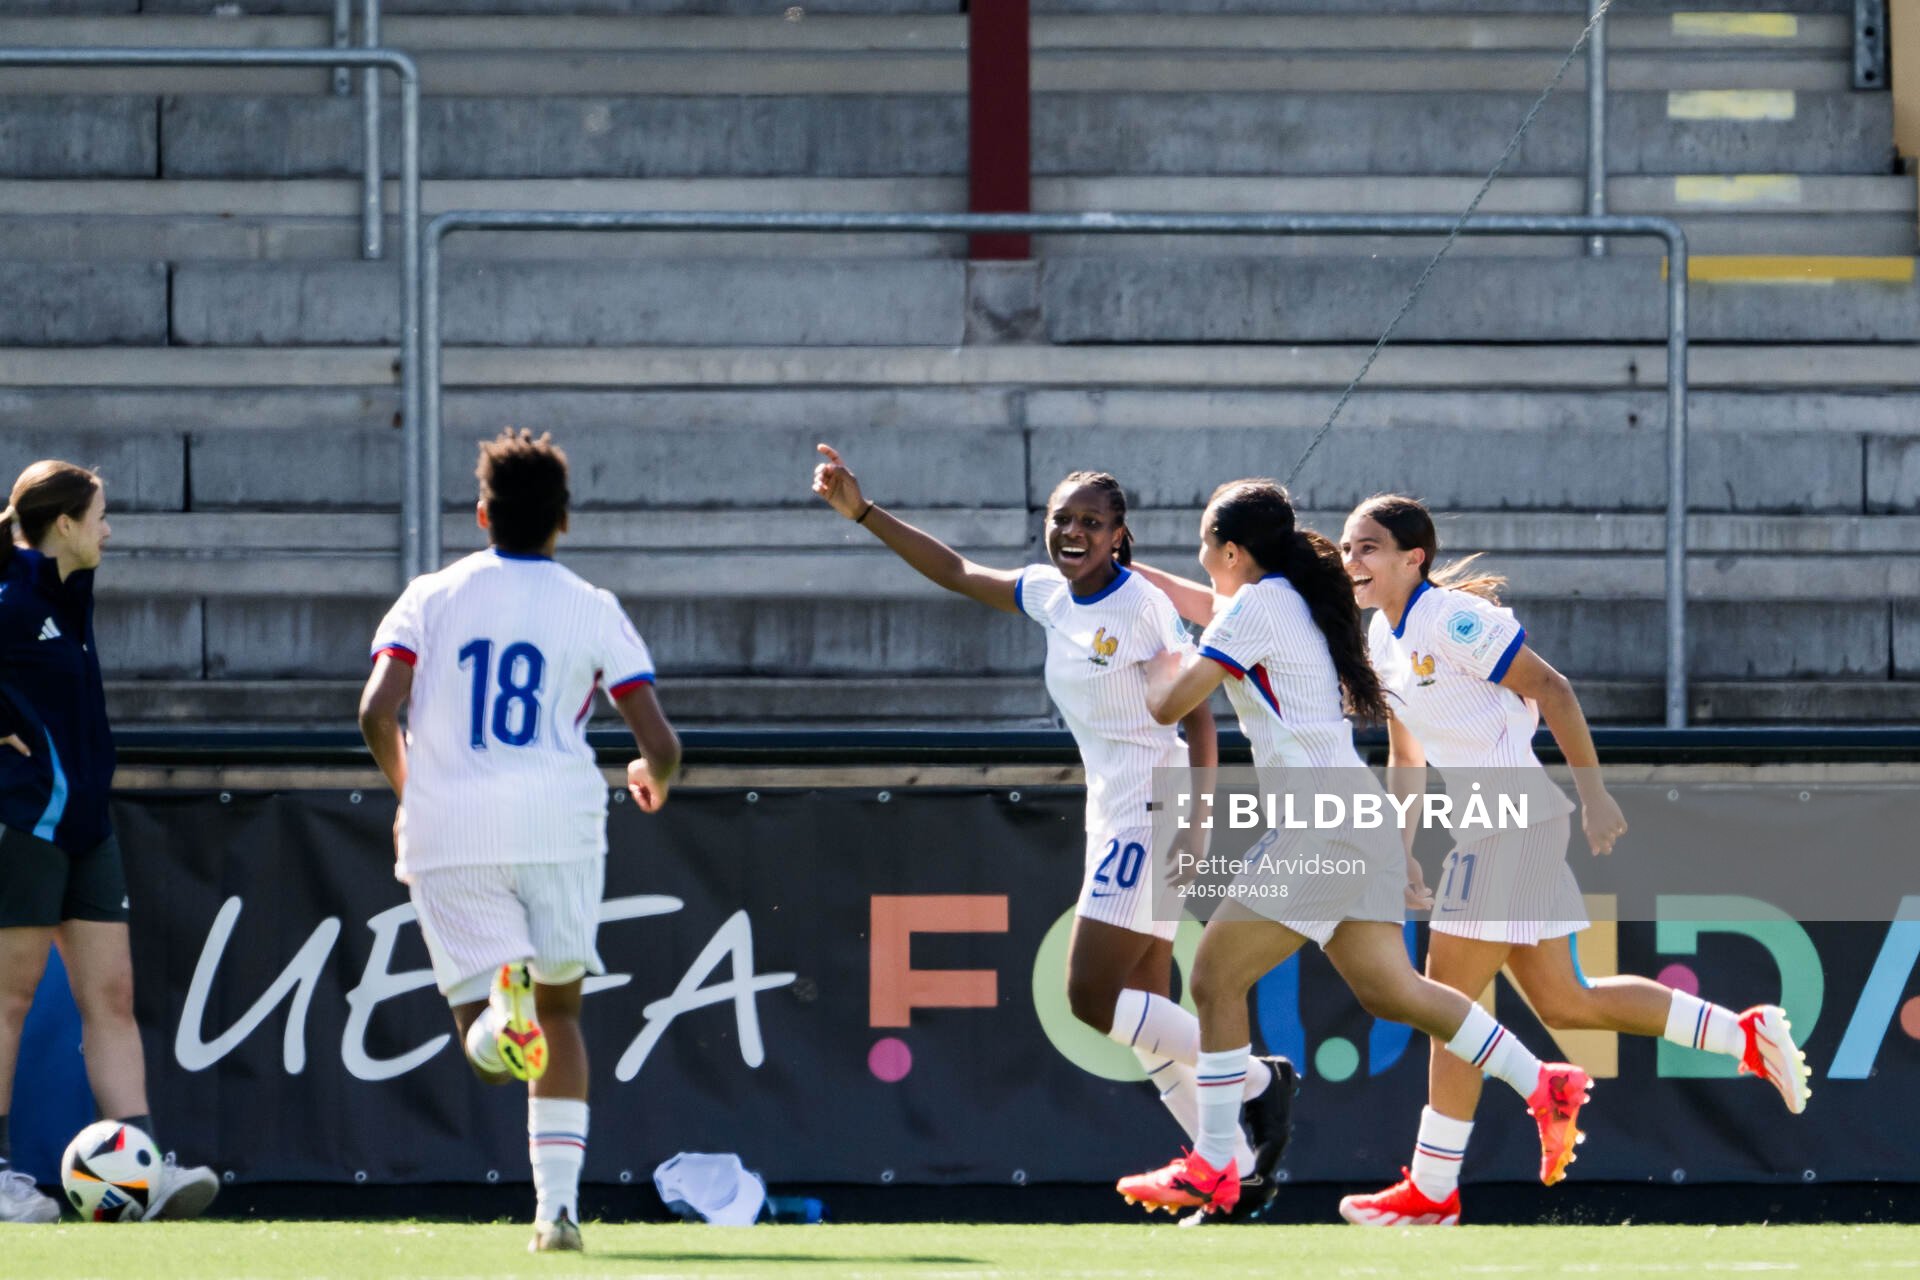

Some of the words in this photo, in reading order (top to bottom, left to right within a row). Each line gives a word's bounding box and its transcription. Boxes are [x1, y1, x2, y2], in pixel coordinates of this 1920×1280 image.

[458, 638, 546, 749] 18
[1094, 838, 1147, 888] 20
[1444, 851, 1477, 902] 11
